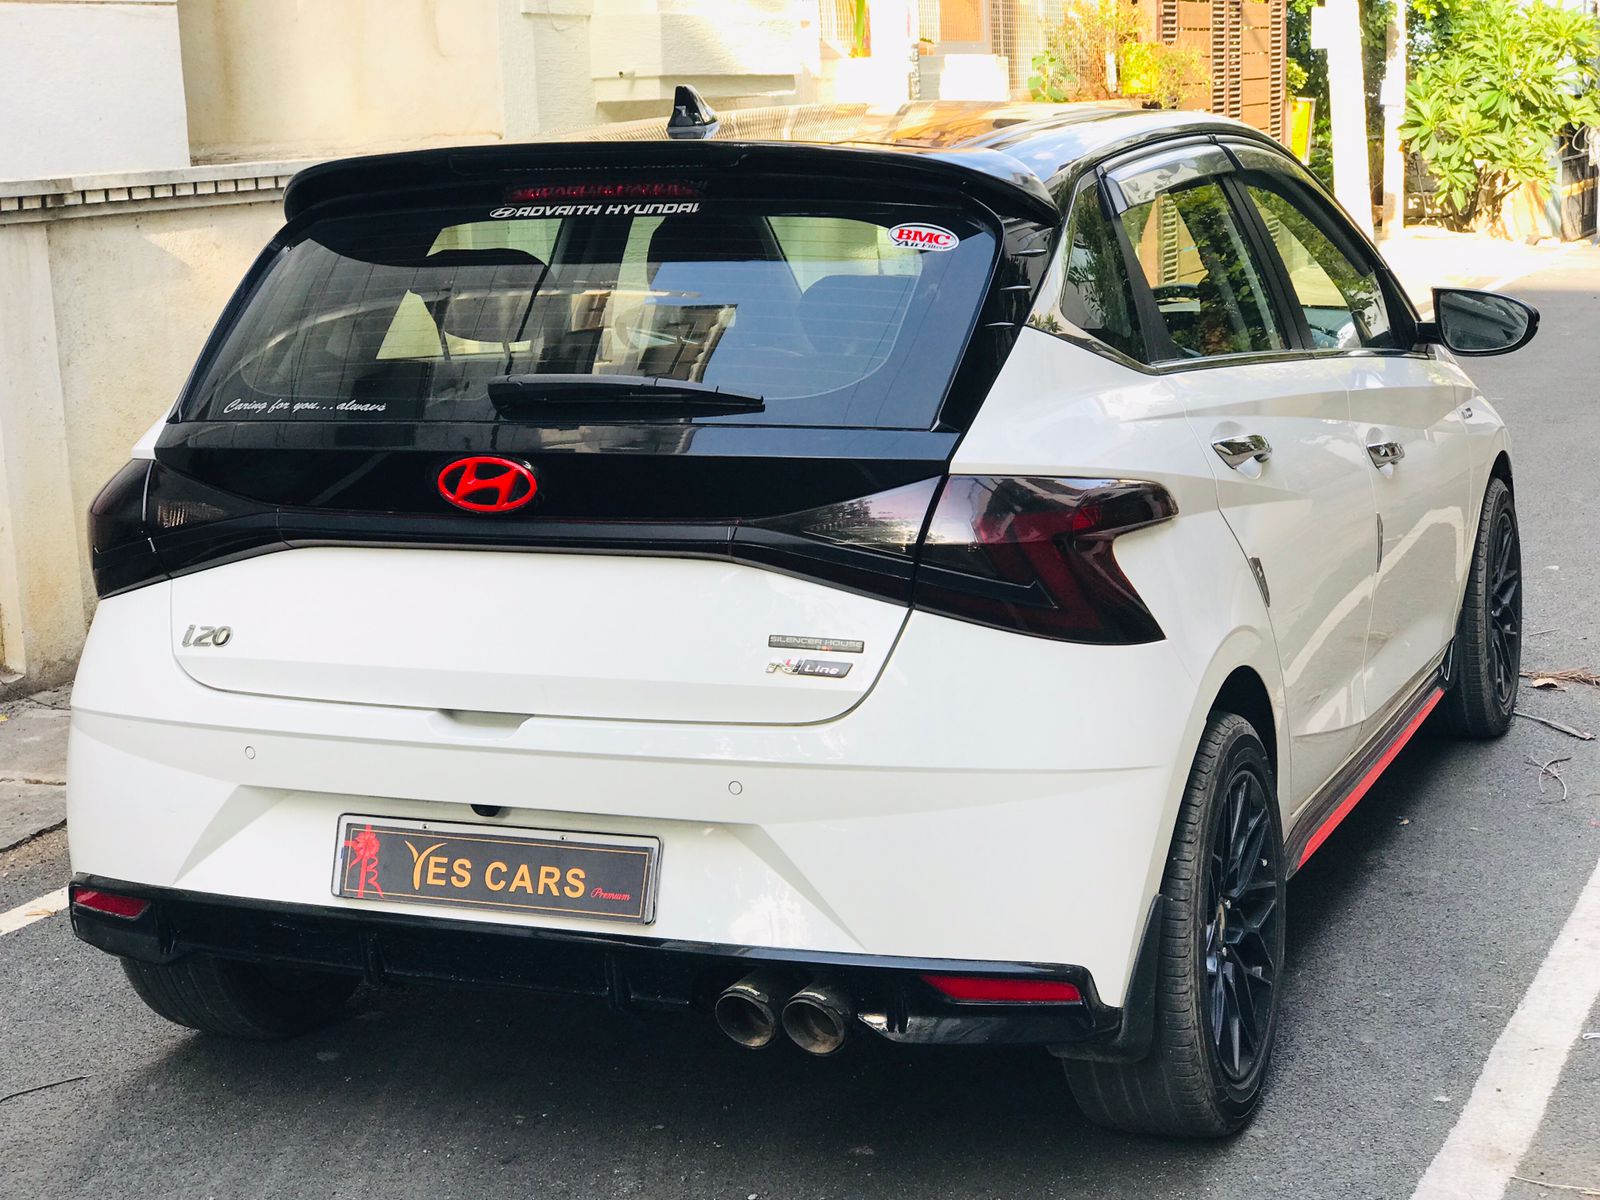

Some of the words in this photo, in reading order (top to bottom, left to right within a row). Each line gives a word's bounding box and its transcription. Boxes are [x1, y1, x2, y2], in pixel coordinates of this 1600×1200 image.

[515, 203, 601, 217] ADVAITH
[605, 202, 700, 215] HYUNDAI
[896, 229, 951, 245] BMC
[223, 398, 267, 413] Caring
[267, 398, 290, 413] for
[770, 635, 822, 645] SILENCER
[824, 639, 864, 648] HOUSE
[804, 663, 840, 676] Line
[404, 839, 472, 891] YES
[484, 861, 586, 898] CARS
[591, 887, 631, 901] Premium
